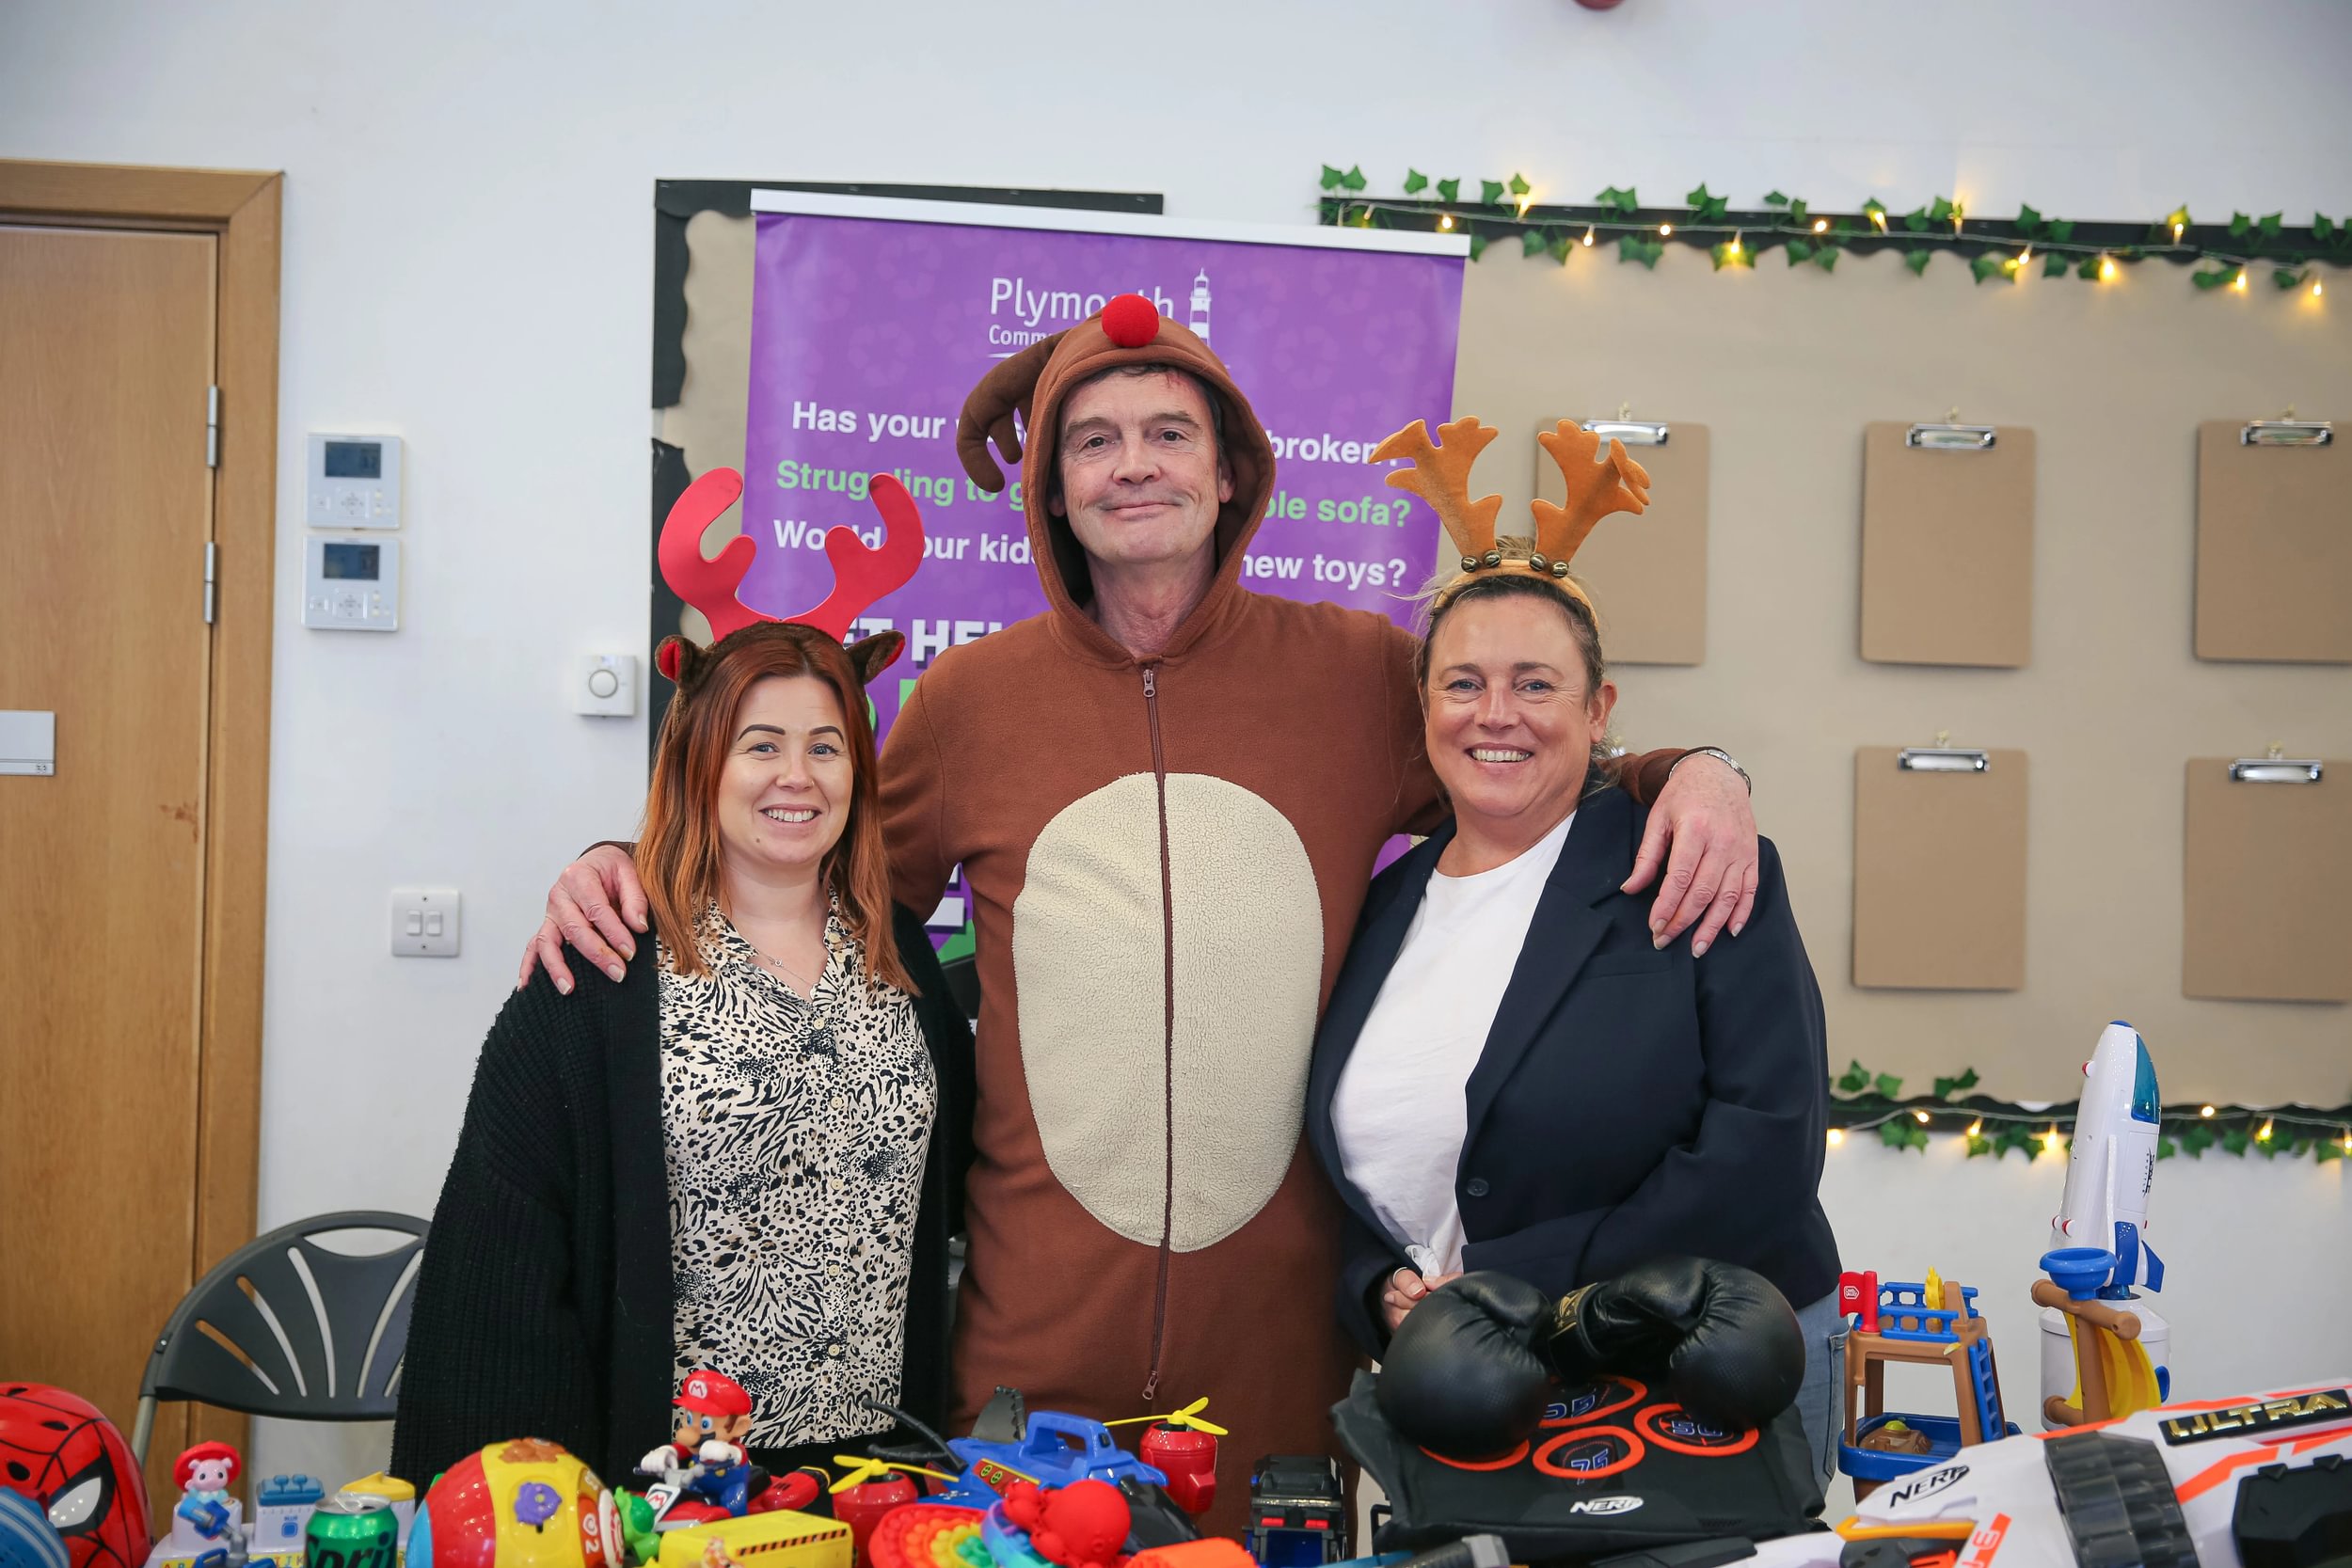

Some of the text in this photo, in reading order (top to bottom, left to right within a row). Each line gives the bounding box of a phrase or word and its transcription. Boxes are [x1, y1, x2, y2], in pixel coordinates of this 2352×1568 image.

[990, 277, 1175, 327] Plymoh
[792, 401, 857, 434] Has
[867, 412, 946, 443] your
[1317, 496, 1411, 528] sofa?
[979, 533, 1035, 565] kid
[1312, 553, 1407, 591] toys?
[2168, 1393, 2347, 1437] ULTRA
[1569, 1496, 1645, 1515] NERF
[1889, 1465, 1971, 1509] NERF
